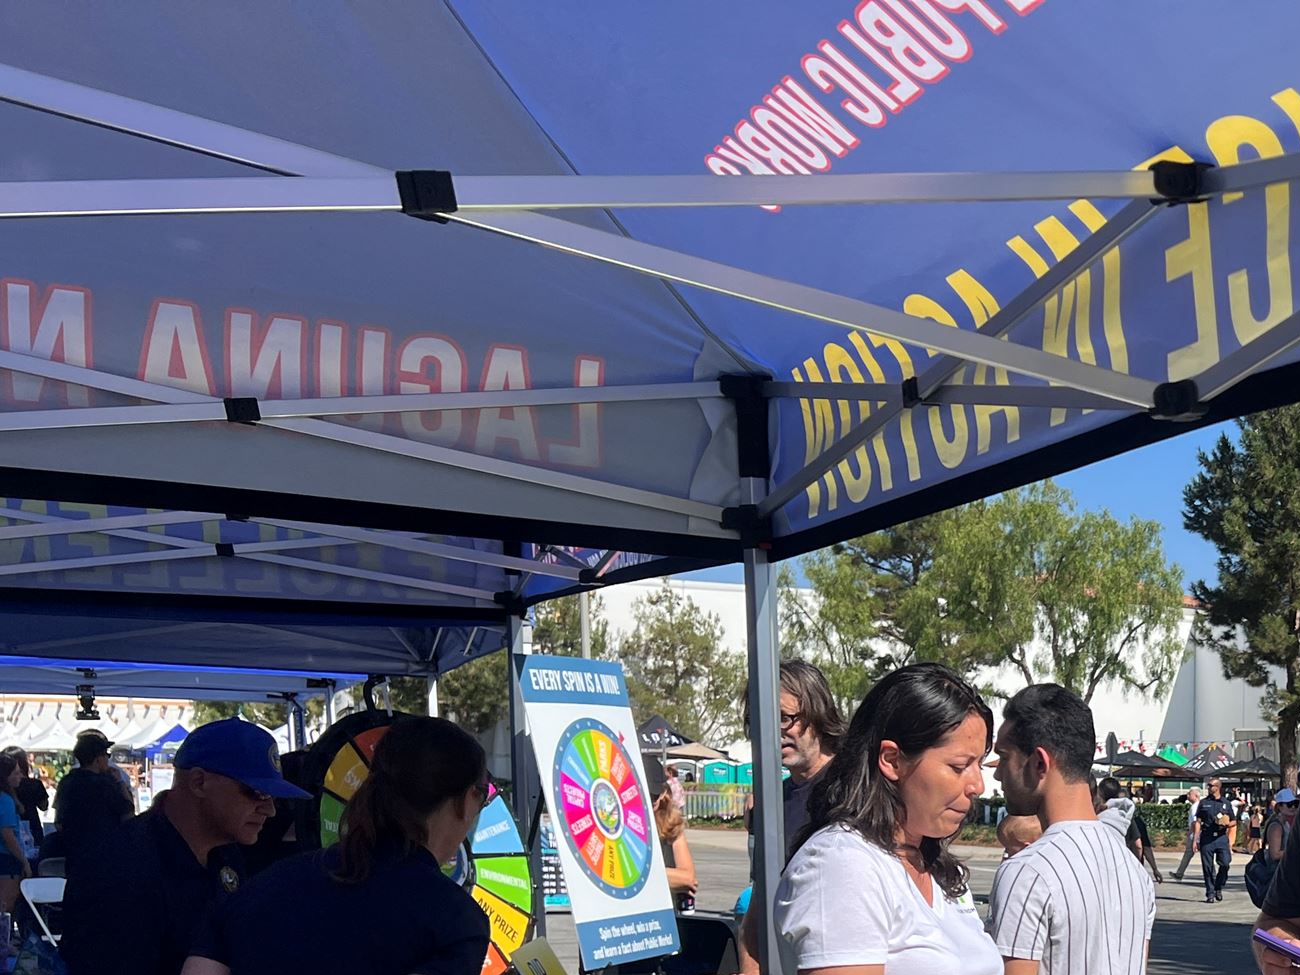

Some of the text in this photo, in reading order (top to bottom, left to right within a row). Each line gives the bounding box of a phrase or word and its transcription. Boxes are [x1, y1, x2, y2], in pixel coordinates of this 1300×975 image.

[528, 668, 621, 695] EVERY SPIN IS A WIN!
[477, 898, 519, 944] ANY PRIZE
[598, 926, 612, 941] Spin
[611, 925, 621, 938] the
[636, 920, 645, 933] win
[593, 946, 605, 960] and
[603, 944, 618, 958] learn
[620, 942, 632, 955] fact
[631, 940, 645, 952] about
[644, 936, 659, 950] Public
